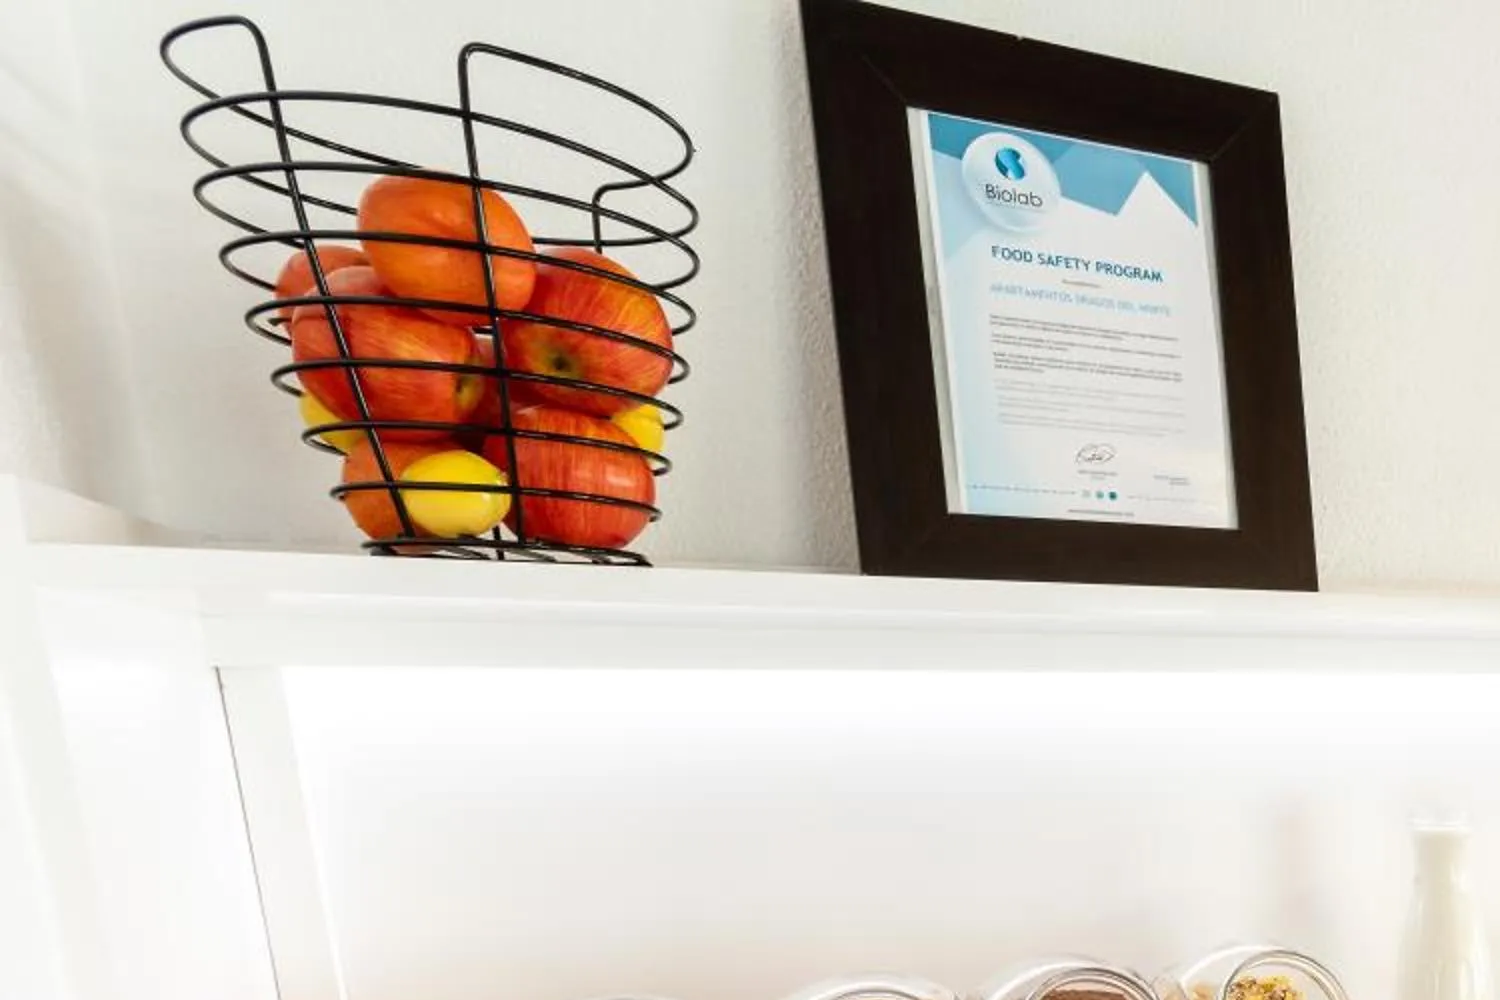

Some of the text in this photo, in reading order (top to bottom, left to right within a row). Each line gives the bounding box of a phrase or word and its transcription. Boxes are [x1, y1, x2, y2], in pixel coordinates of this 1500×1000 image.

[985, 183, 1043, 207] Biolab
[991, 245, 1164, 283] FOOD SAFETY PROGRAM
